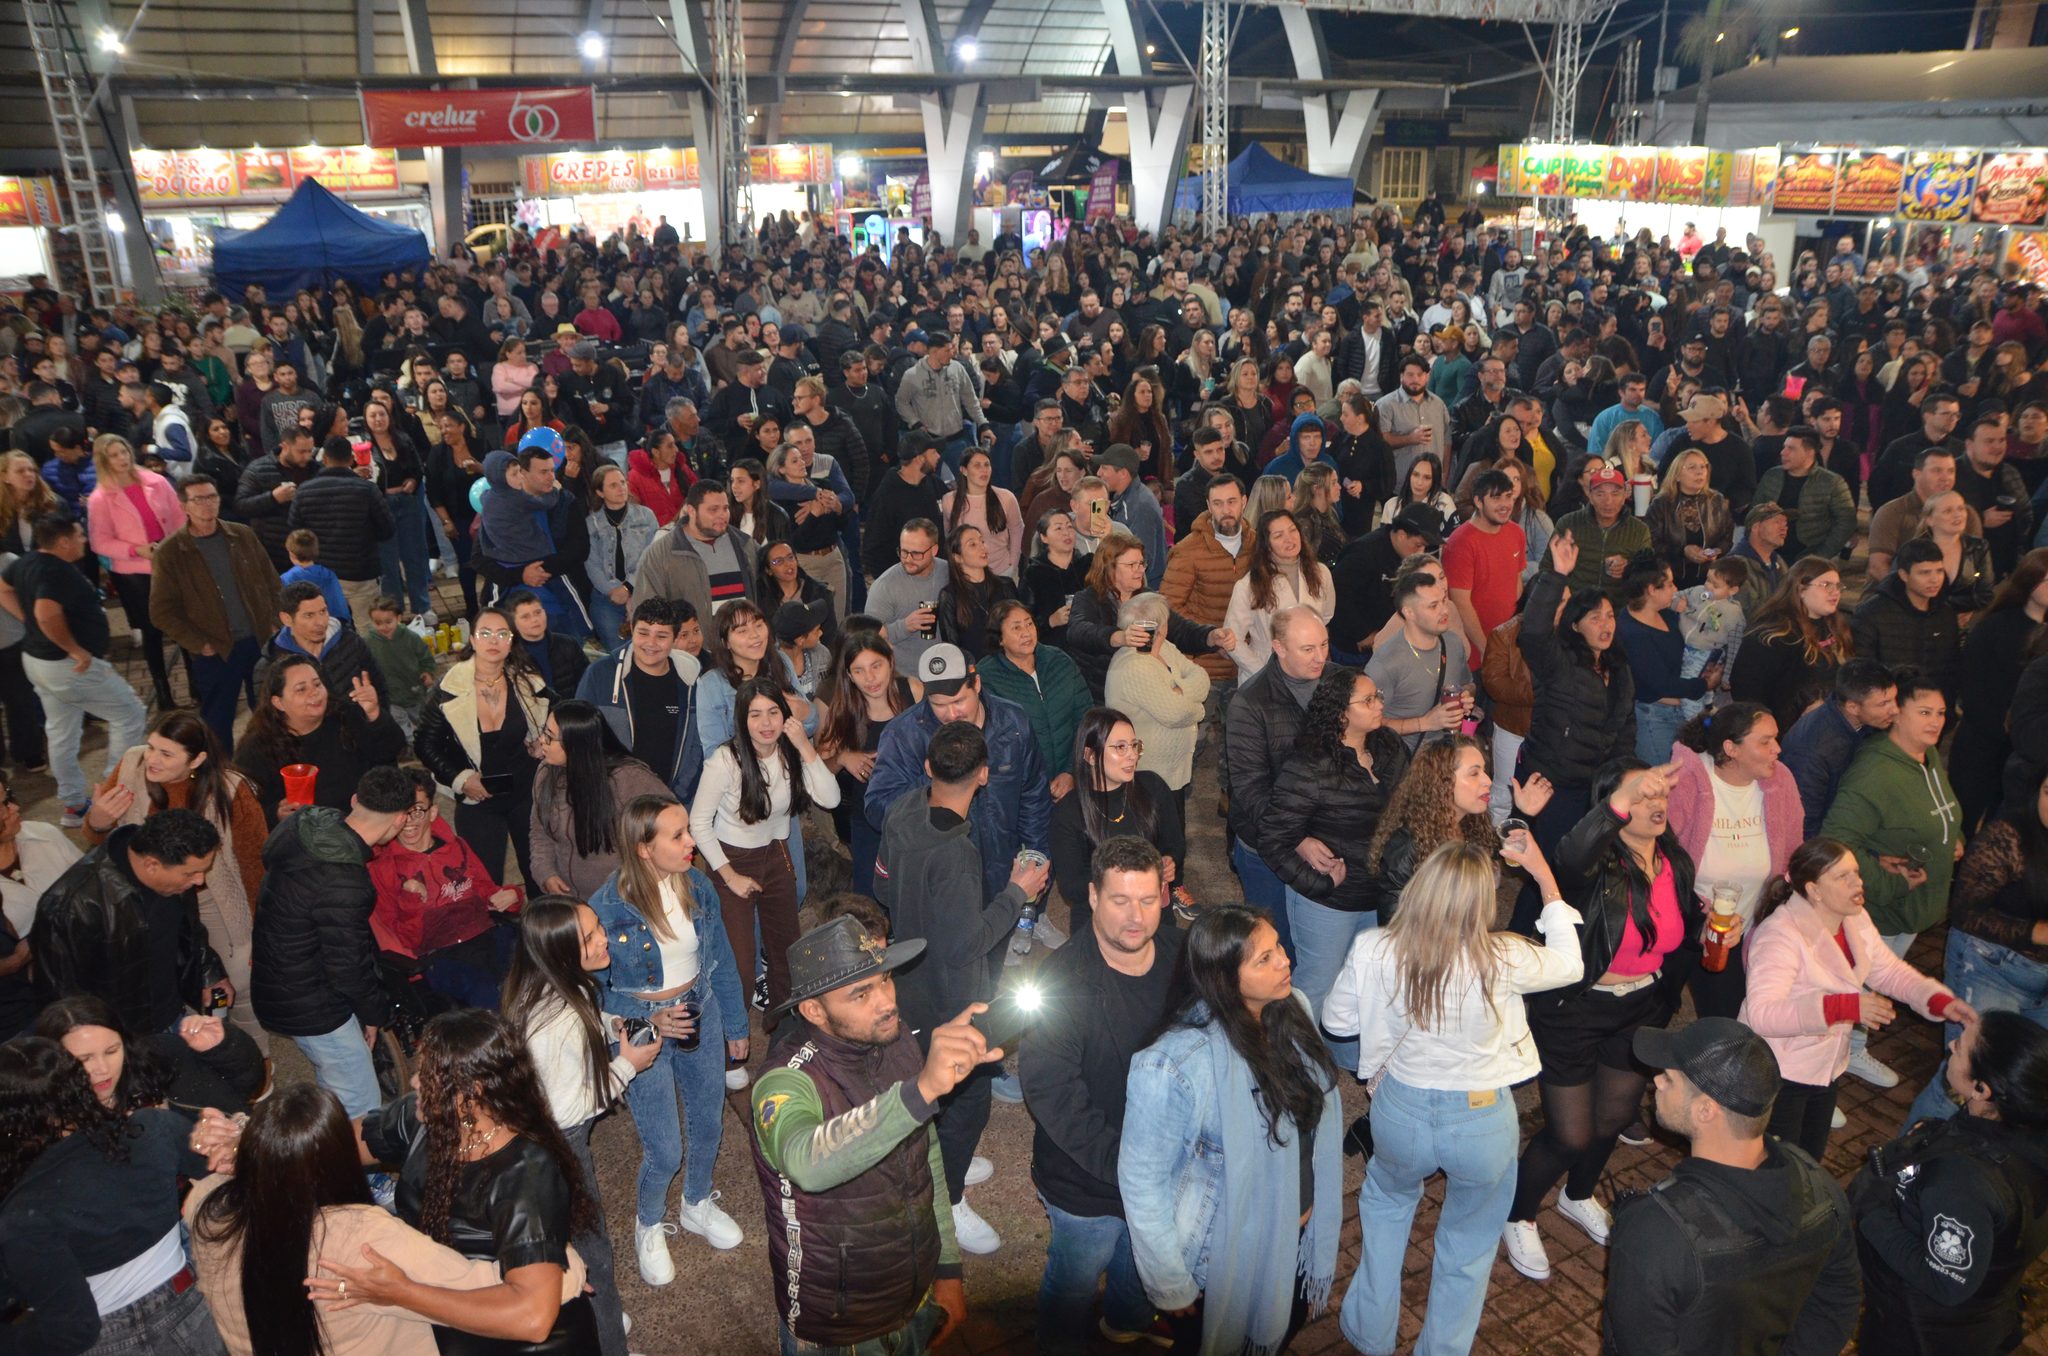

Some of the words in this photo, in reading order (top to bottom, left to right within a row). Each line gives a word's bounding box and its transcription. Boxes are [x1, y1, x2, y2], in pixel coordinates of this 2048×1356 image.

[404, 103, 477, 128] creluz
[551, 159, 636, 182] CREPES
[1523, 157, 1602, 177] CAIPIRAS
[1609, 156, 1705, 184] DRINKS
[1712, 815, 1762, 830] MILANO
[809, 1095, 877, 1166] AGRO
